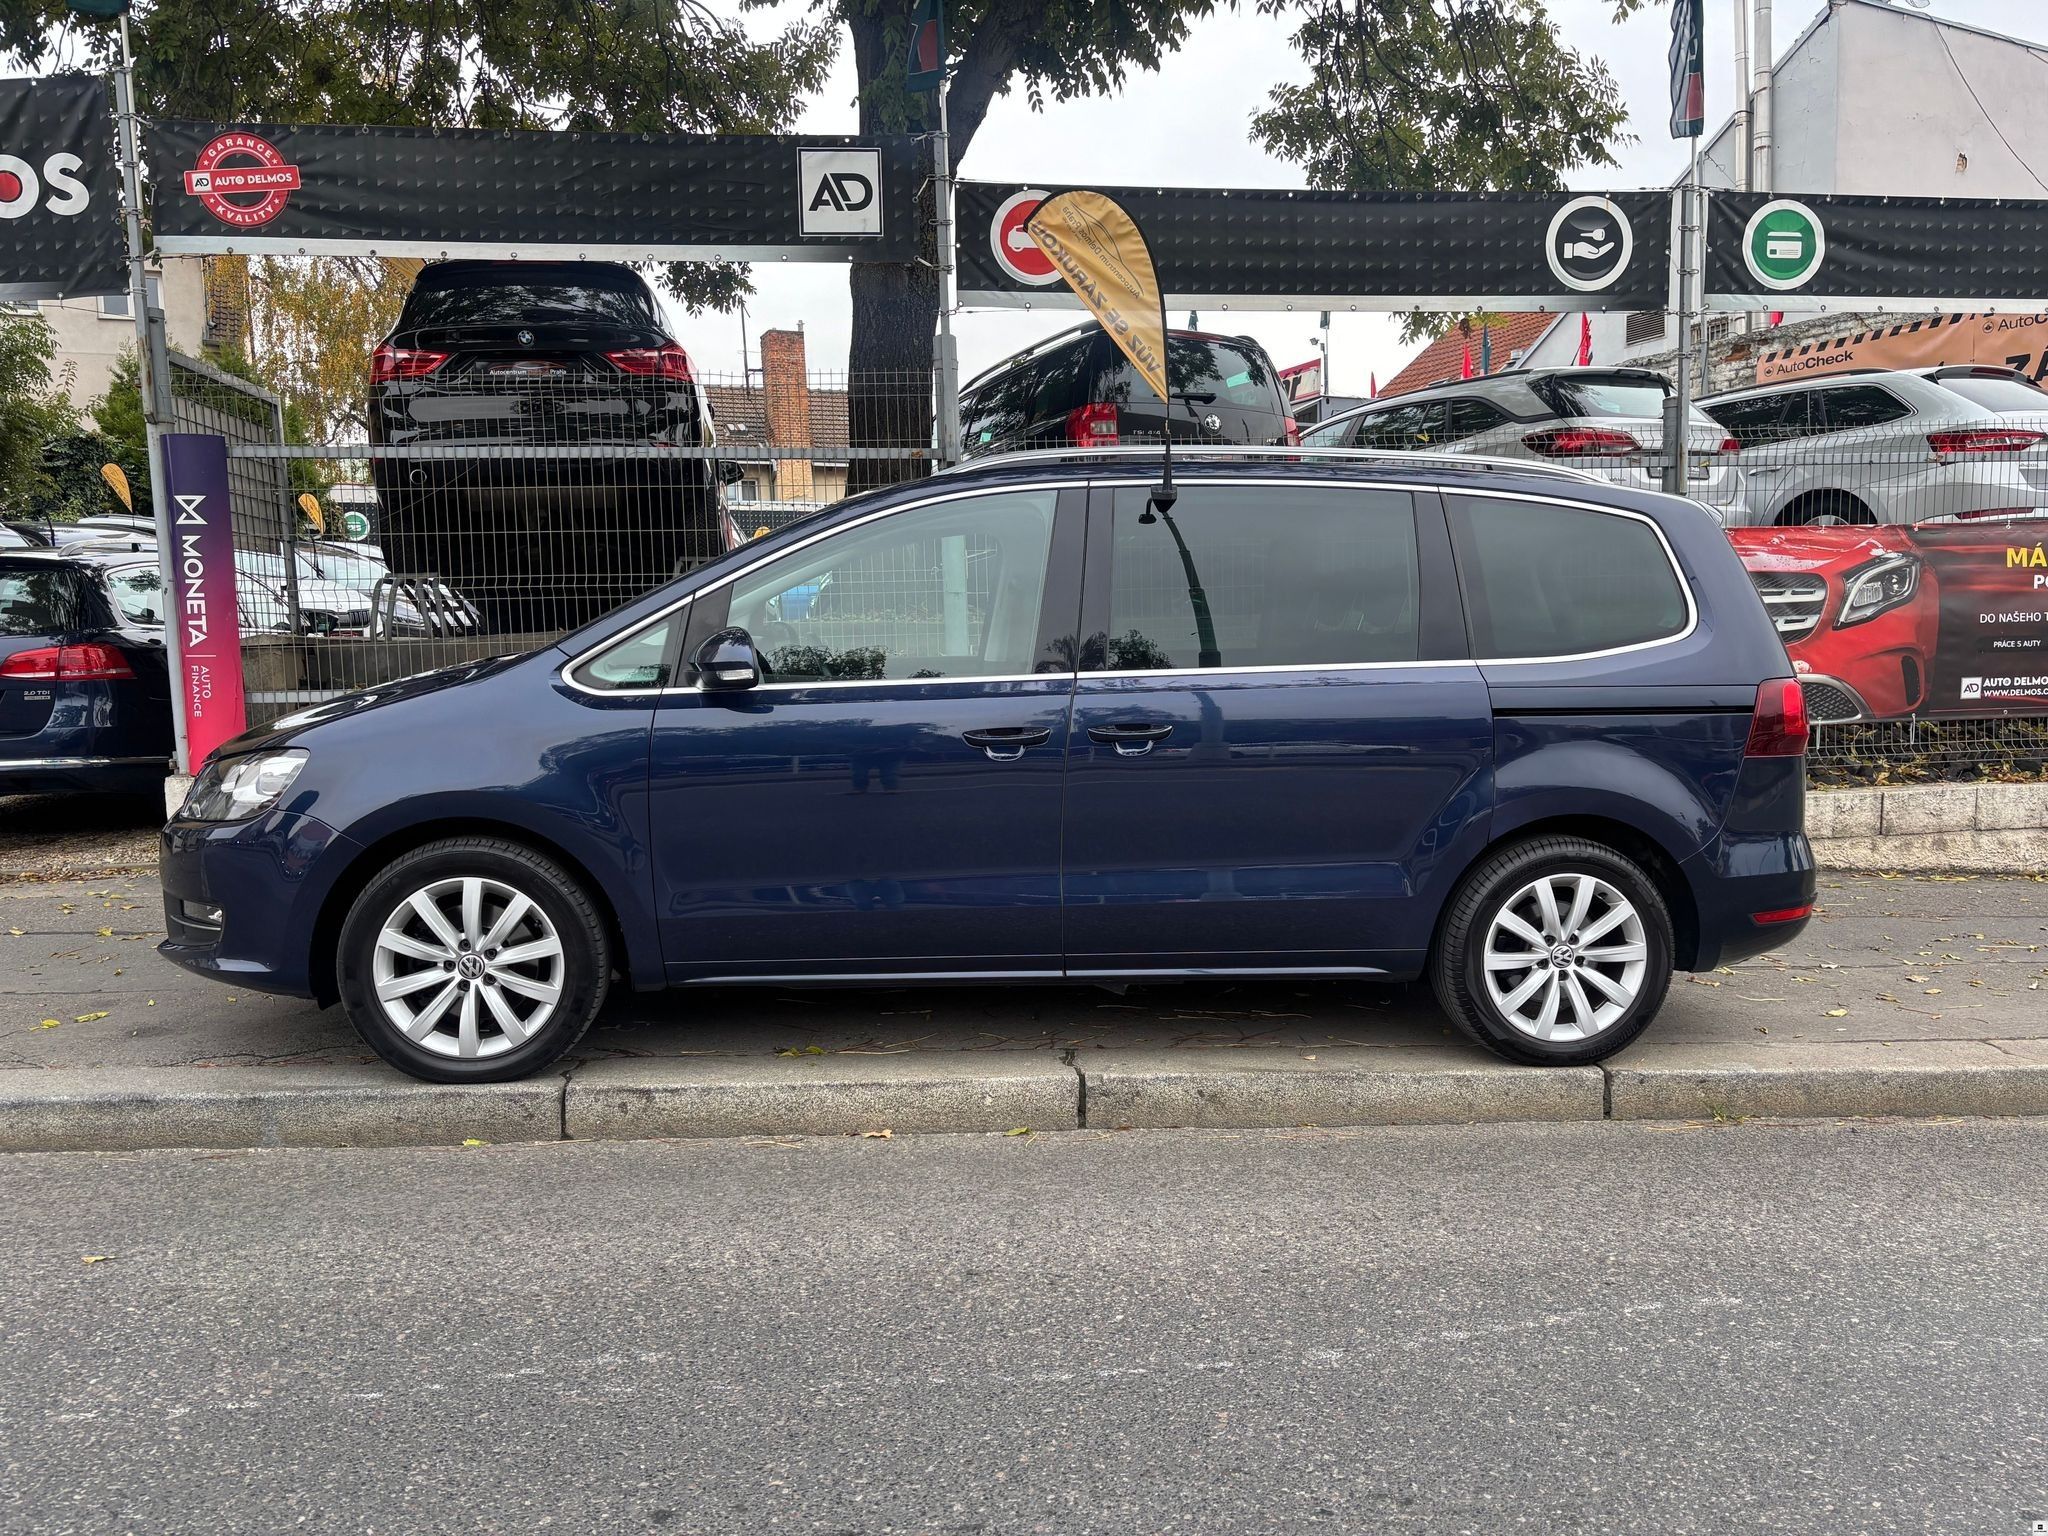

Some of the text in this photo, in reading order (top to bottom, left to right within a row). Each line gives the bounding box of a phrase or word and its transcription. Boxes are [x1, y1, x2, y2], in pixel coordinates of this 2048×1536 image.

[207, 137, 273, 159] GARANCE
[214, 175, 245, 186] AUTO
[247, 173, 293, 184] DELMOS
[216, 204, 274, 223] KVALITY
[1776, 350, 1854, 375] AutoCheck
[2006, 542, 2048, 568] MÁ
[181, 535, 208, 648] MONETA
[1979, 613, 1996, 624] DO
[1998, 610, 2042, 623] NAŠEHO
[1993, 639, 2042, 648] PRÁCE S AUTY
[190, 664, 203, 718] FINANCE
[199, 665, 212, 699] AUTO
[1983, 677, 2012, 687] AUTO
